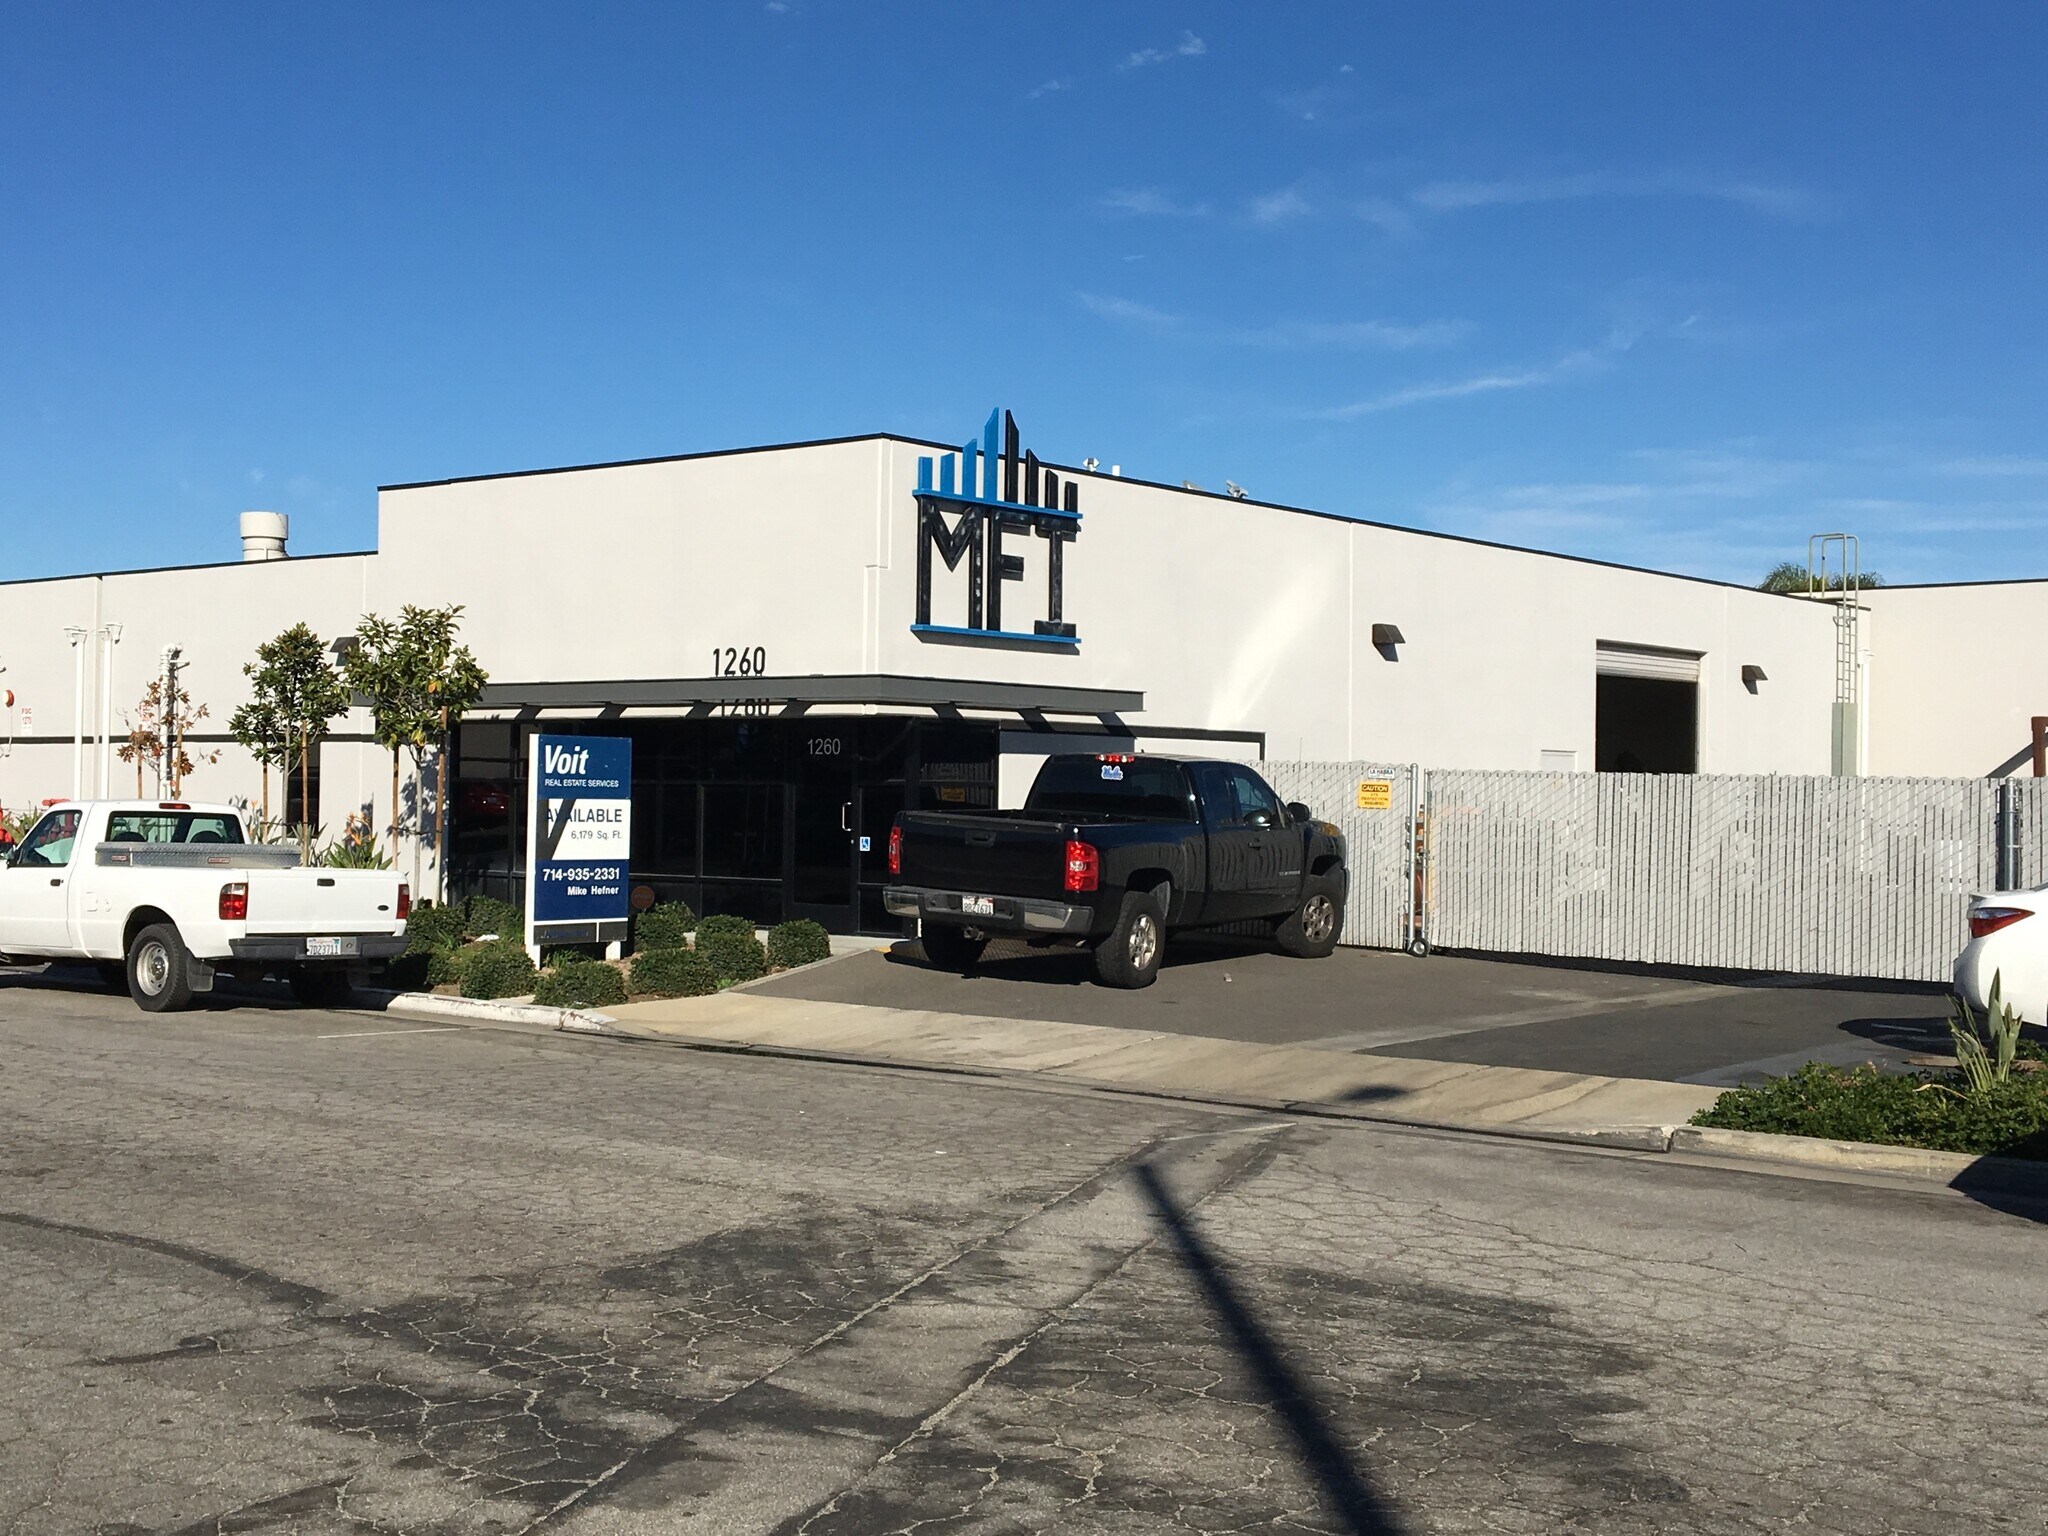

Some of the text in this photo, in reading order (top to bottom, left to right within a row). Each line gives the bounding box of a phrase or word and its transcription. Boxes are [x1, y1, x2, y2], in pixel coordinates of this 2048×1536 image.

[713, 646, 766, 677] 1260
[807, 738, 841, 755] 1260
[544, 745, 589, 775] Voit
[544, 778, 619, 788] REAL ESTATE SERVICES
[548, 808, 623, 823] AILABLE
[570, 830, 593, 840] 6,179
[542, 867, 620, 881] 714-935-2331
[567, 885, 620, 896] Mike Hefner
